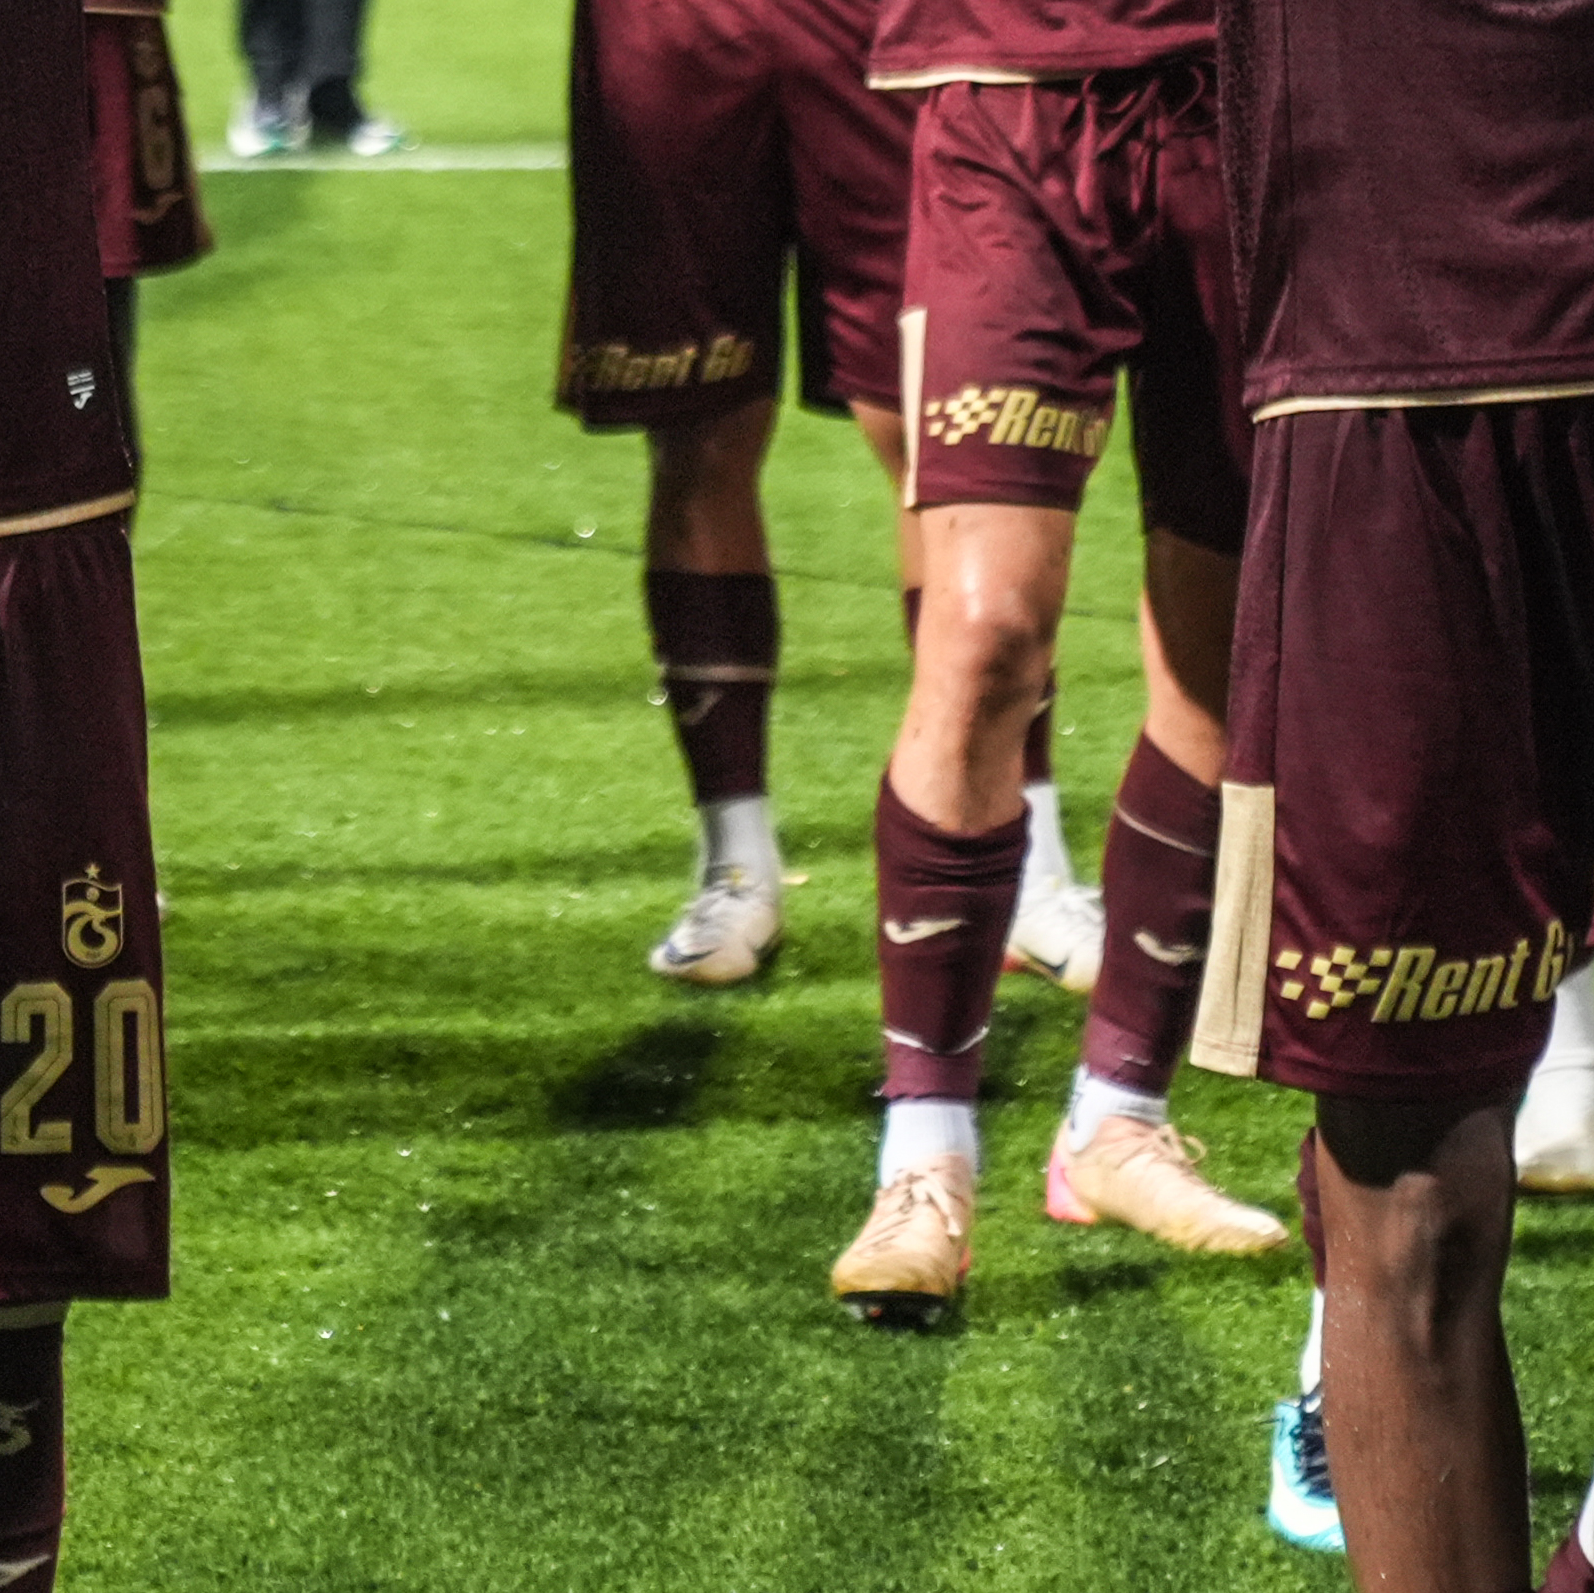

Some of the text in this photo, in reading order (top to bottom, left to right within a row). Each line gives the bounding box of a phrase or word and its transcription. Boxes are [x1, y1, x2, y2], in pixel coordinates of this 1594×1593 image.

[1370, 919, 1573, 1023] Rent G
[0, 979, 164, 1156] 20
